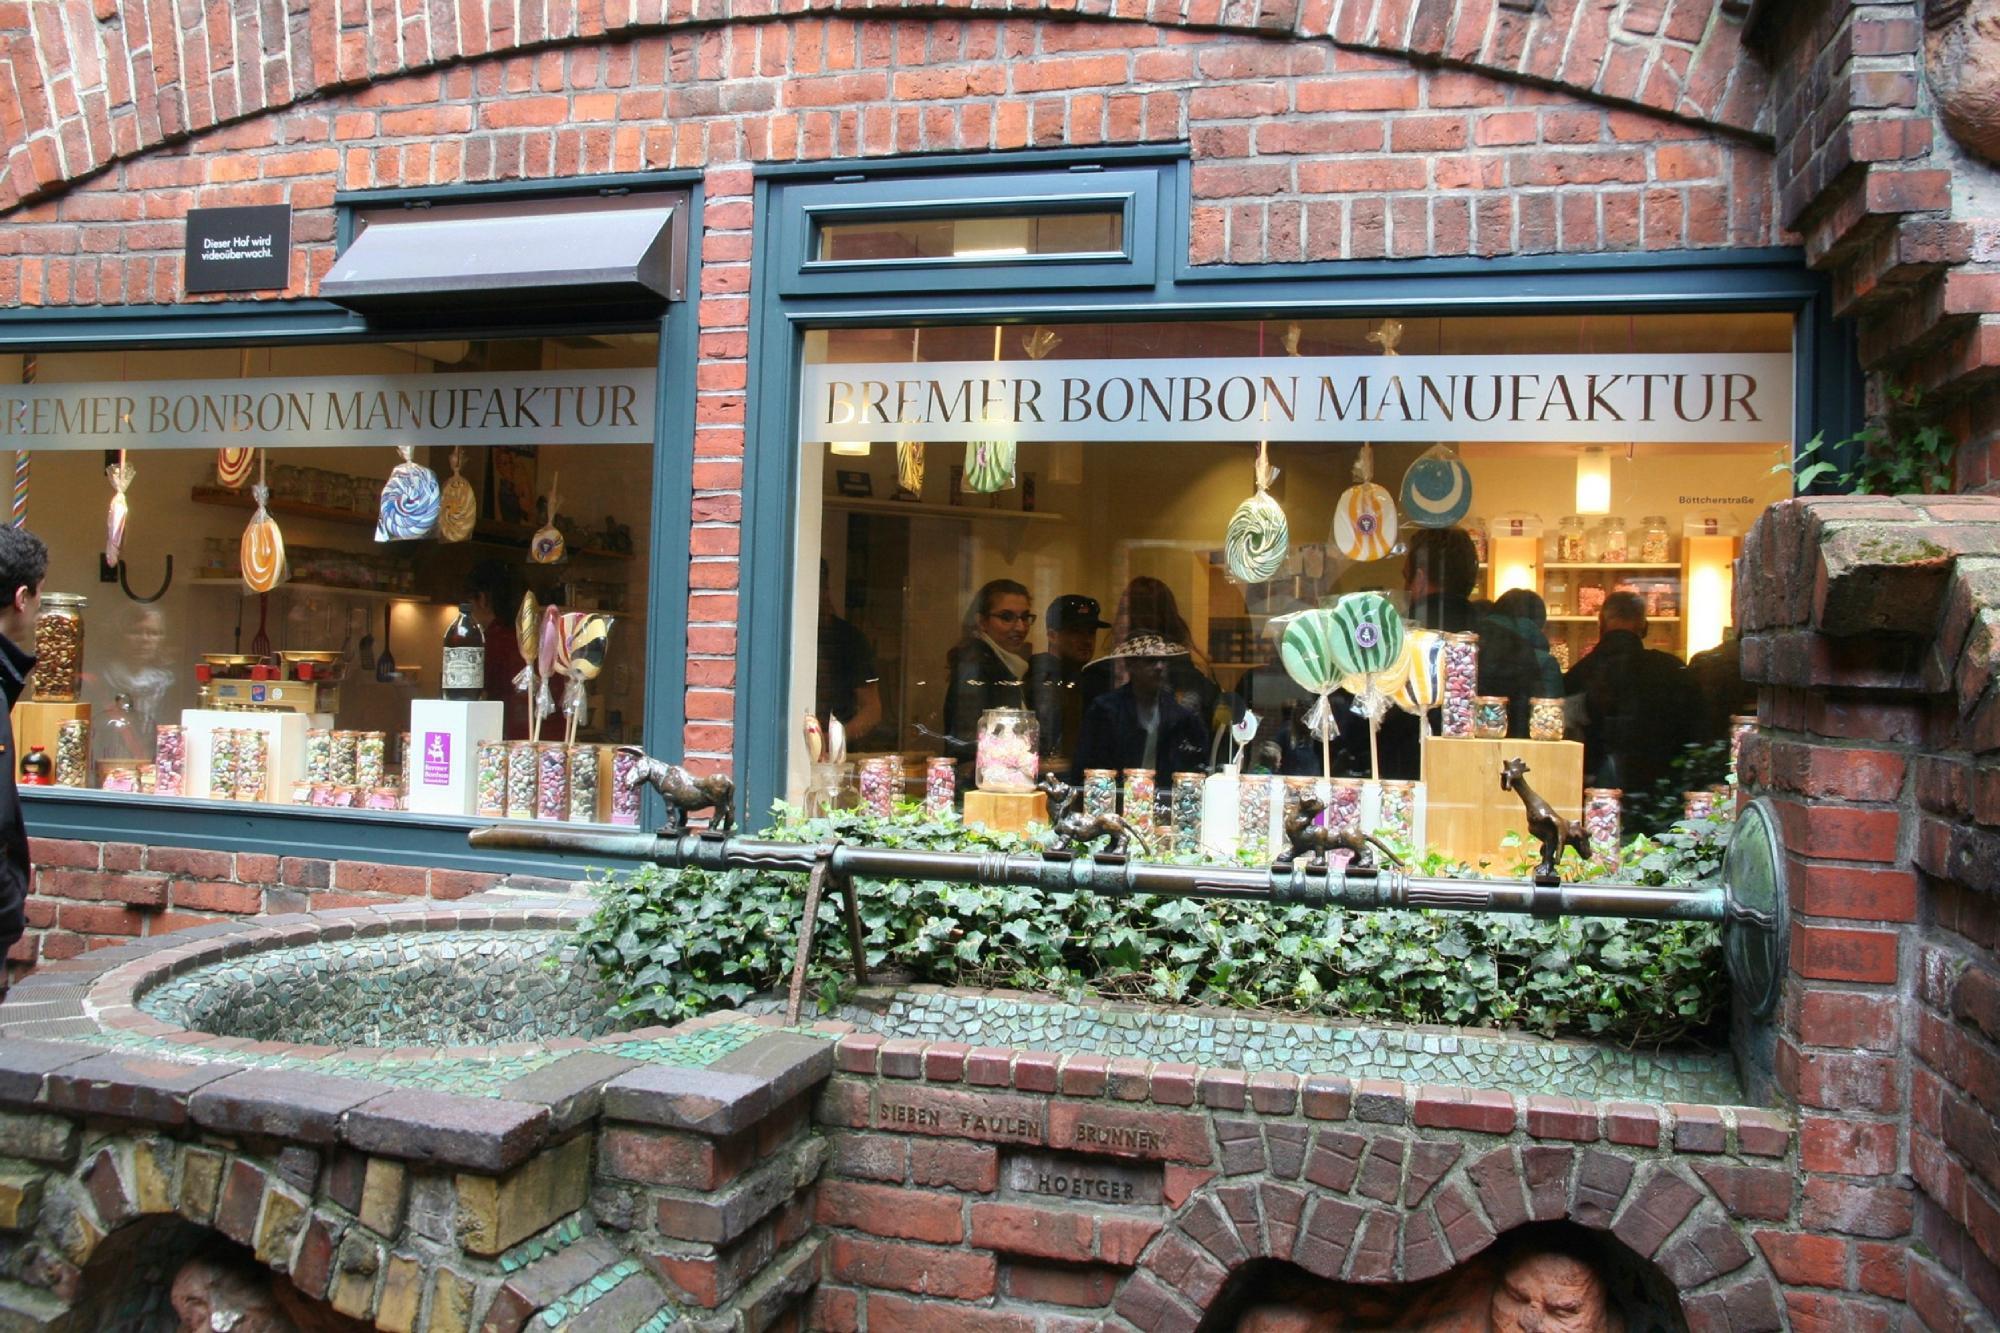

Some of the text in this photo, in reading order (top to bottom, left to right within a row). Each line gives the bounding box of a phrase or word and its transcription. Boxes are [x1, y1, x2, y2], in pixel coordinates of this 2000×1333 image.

[201, 247, 273, 261] videoüberwacht.
[203, 233, 272, 249] Dieser Hof wird
[0, 384, 639, 436] REMER BONBON MANUFAKTUR
[823, 373, 1763, 425] BREMER BONBON MANUFAKTUR
[1679, 495, 1755, 505] Böttcherstraße
[880, 1103, 1161, 1150] SIEBEN FAULEN BRUNNEN
[1038, 1172, 1134, 1200] HOETGER
